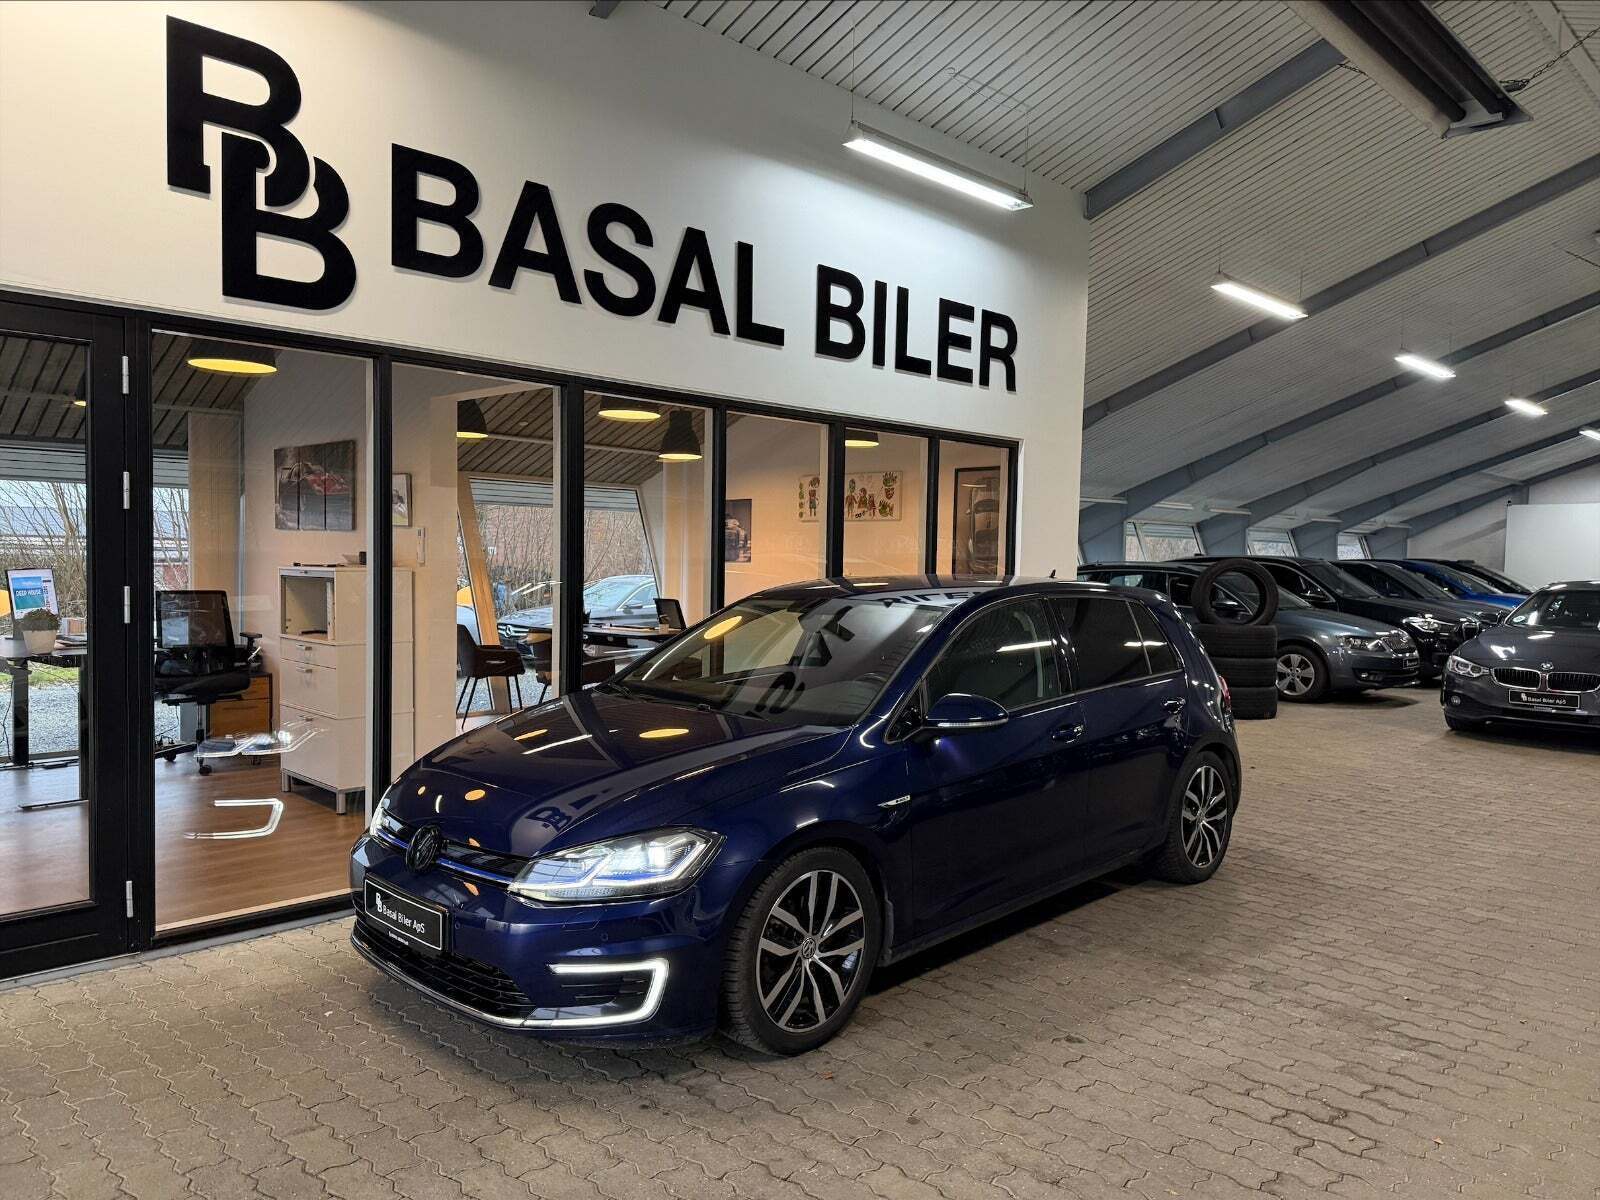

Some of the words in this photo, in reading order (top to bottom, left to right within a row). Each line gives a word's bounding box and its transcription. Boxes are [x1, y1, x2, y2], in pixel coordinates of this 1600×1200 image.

[391, 142, 785, 347] BASAL
[815, 264, 1019, 392] BILER
[383, 904, 397, 920] Basal
[398, 912, 412, 927] Biler
[412, 919, 425, 933] ApS
